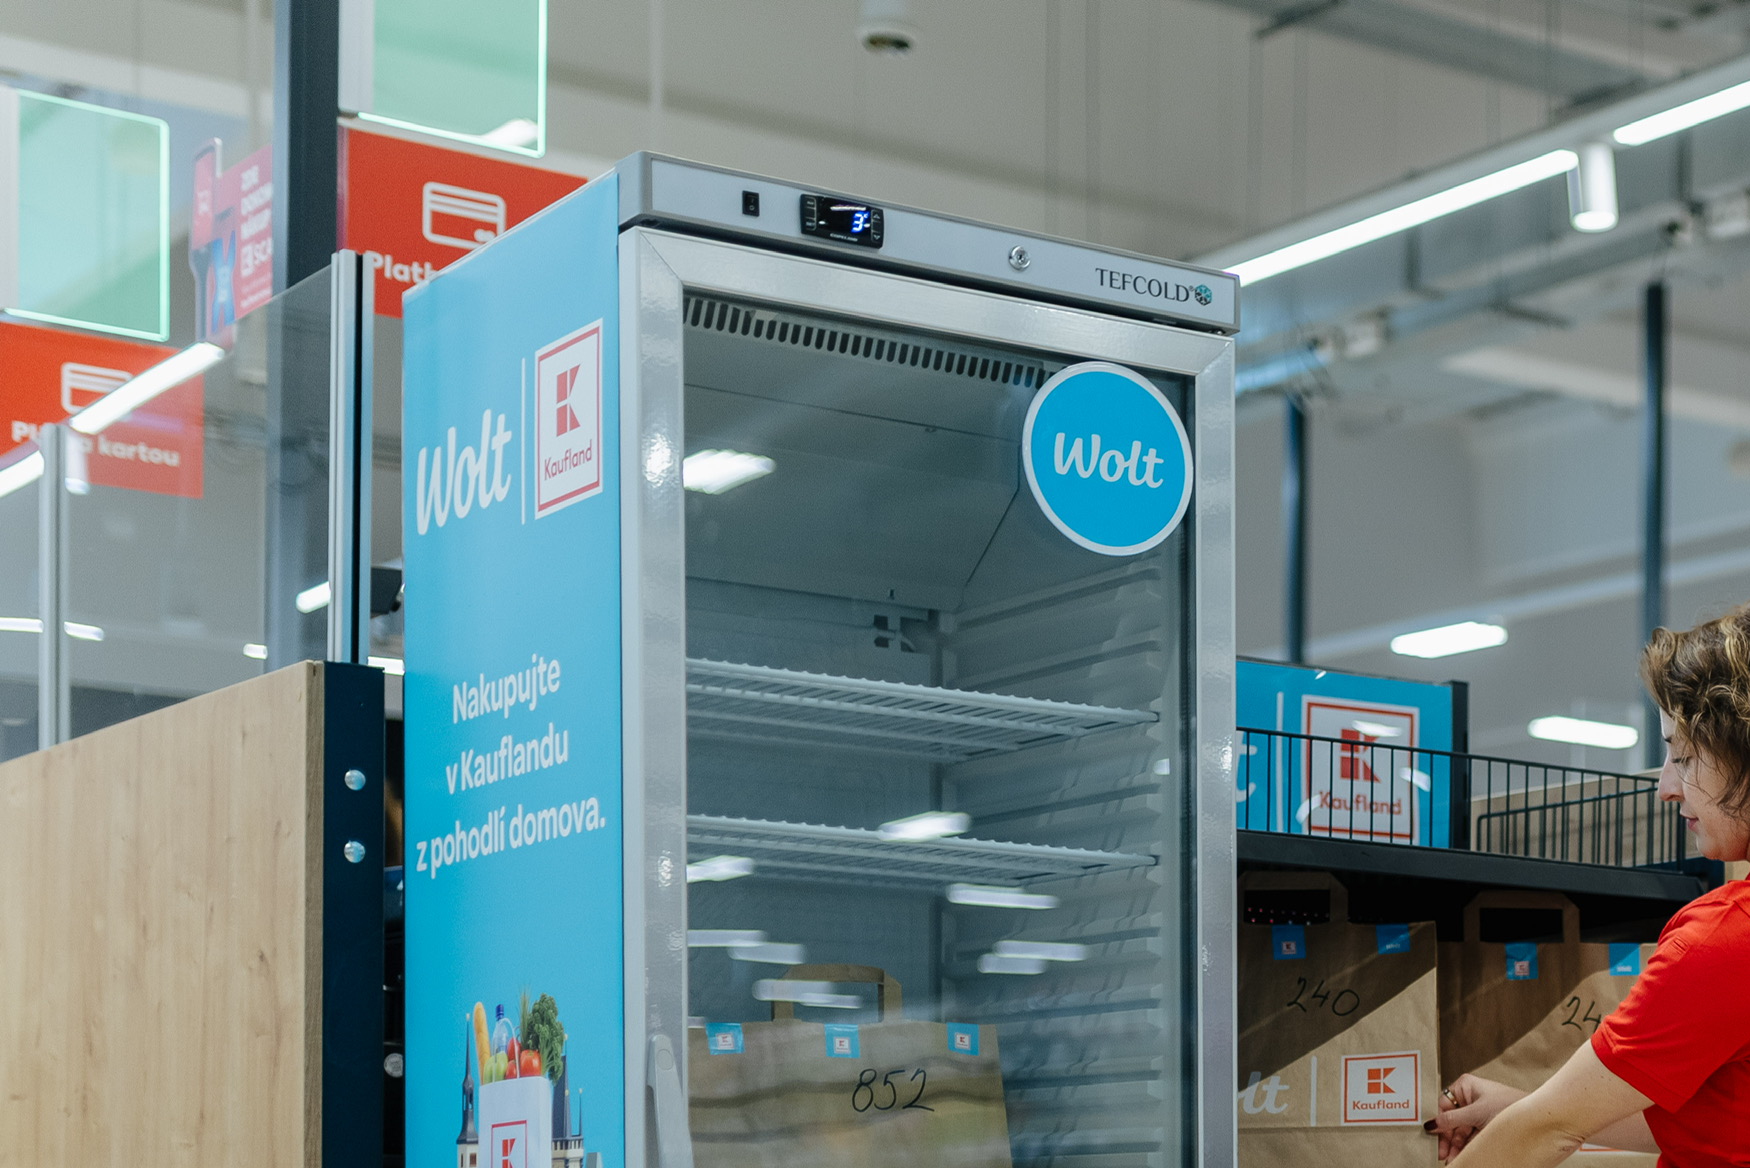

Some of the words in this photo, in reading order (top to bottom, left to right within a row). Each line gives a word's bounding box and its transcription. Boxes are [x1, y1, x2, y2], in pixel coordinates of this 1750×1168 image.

[98, 434, 180, 468] kartou
[416, 409, 512, 535] Wolt
[544, 440, 592, 480] Kaufland
[1053, 432, 1164, 488] Wolt
[453, 653, 560, 724] Nakupujte
[446, 763, 458, 795] v
[461, 722, 568, 791] Kauflandu
[1319, 791, 1402, 815] Kaufland
[416, 841, 428, 872] z
[431, 806, 506, 879] pohodlí
[509, 797, 606, 848] domova.
[1287, 976, 1360, 1017] 240
[852, 1068, 935, 1113] 852
[1237, 1071, 1290, 1115] lt
[1352, 1099, 1410, 1111] Kaufland
